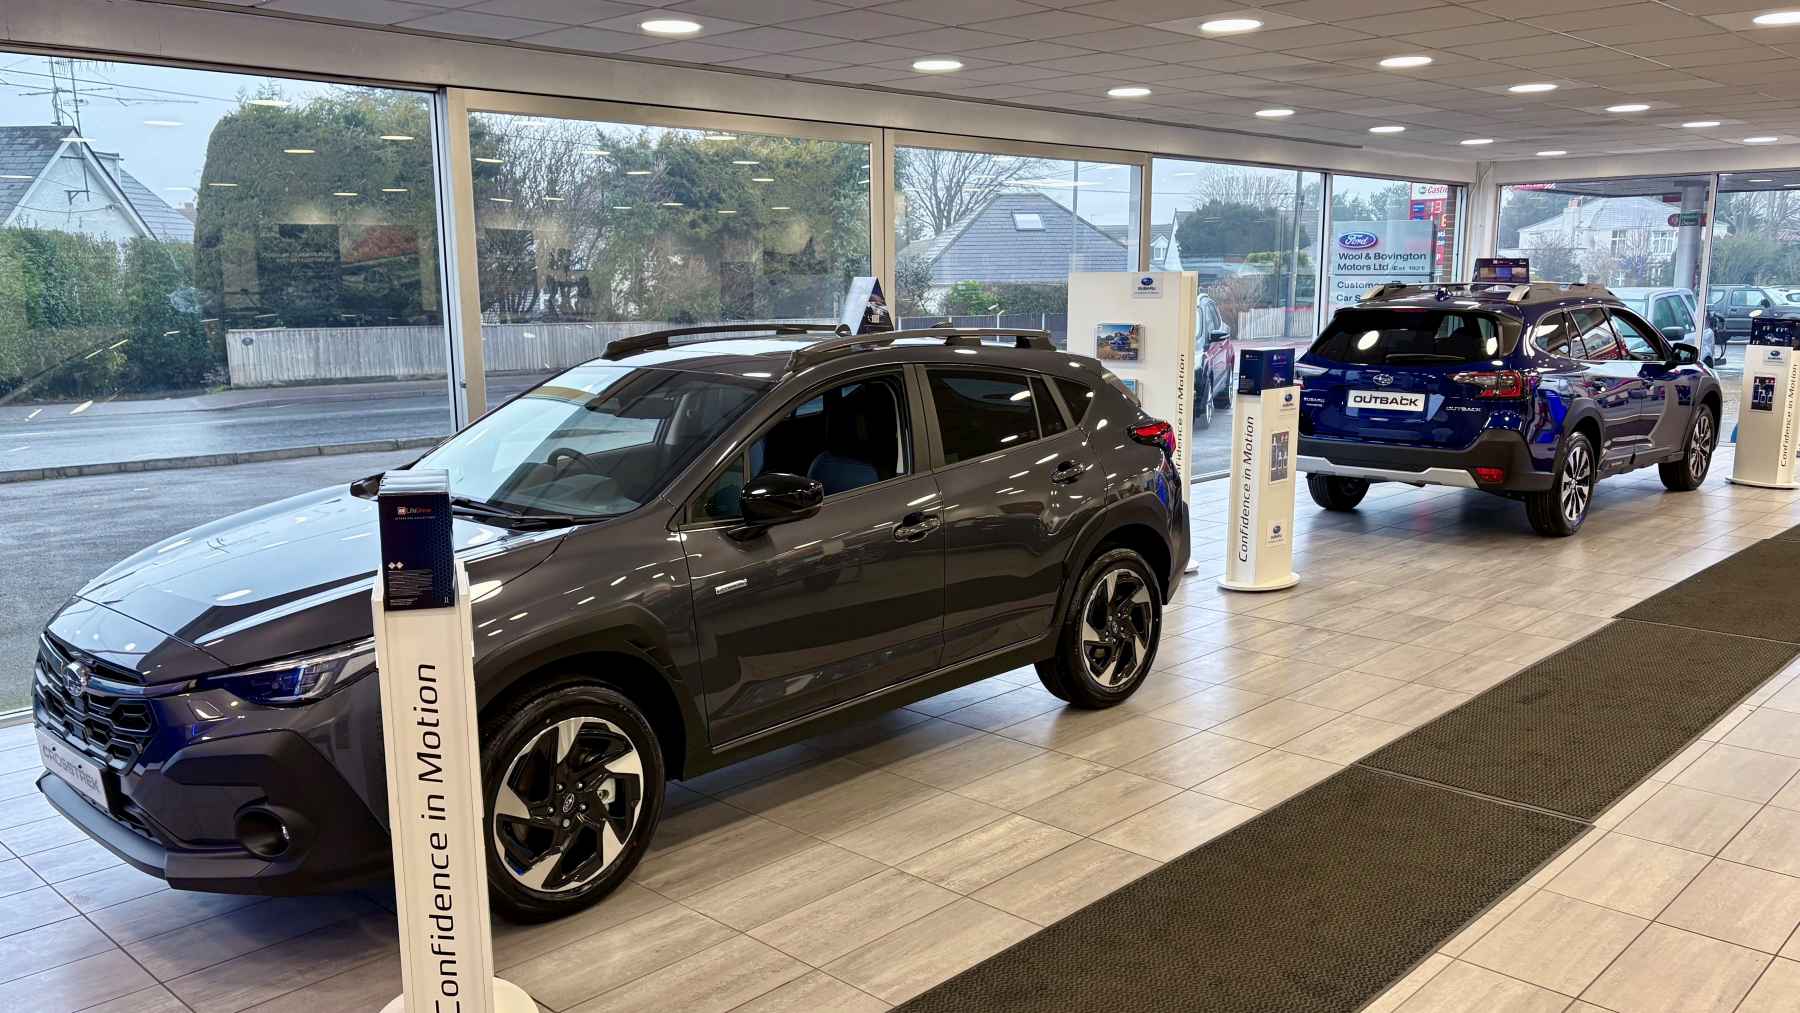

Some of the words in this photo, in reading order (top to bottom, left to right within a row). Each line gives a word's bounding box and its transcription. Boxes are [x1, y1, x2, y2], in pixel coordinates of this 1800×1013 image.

[1344, 233, 1369, 246] Ford
[1338, 252, 1363, 261] Wool
[1364, 252, 1372, 261] &
[1373, 251, 1427, 263] Bovington
[1337, 263, 1371, 272] Motors
[1373, 263, 1388, 272] Ltd
[1337, 280, 1377, 290] Custom
[1336, 294, 1352, 303] Car
[1177, 353, 1185, 400] Motion
[1353, 394, 1420, 407] OUTBACK
[1243, 416, 1254, 466] Motion
[1242, 467, 1252, 481] in
[1238, 483, 1251, 562] Confidence
[413, 663, 444, 784] Motion
[421, 794, 447, 821] in
[428, 832, 461, 1013] Confidence
